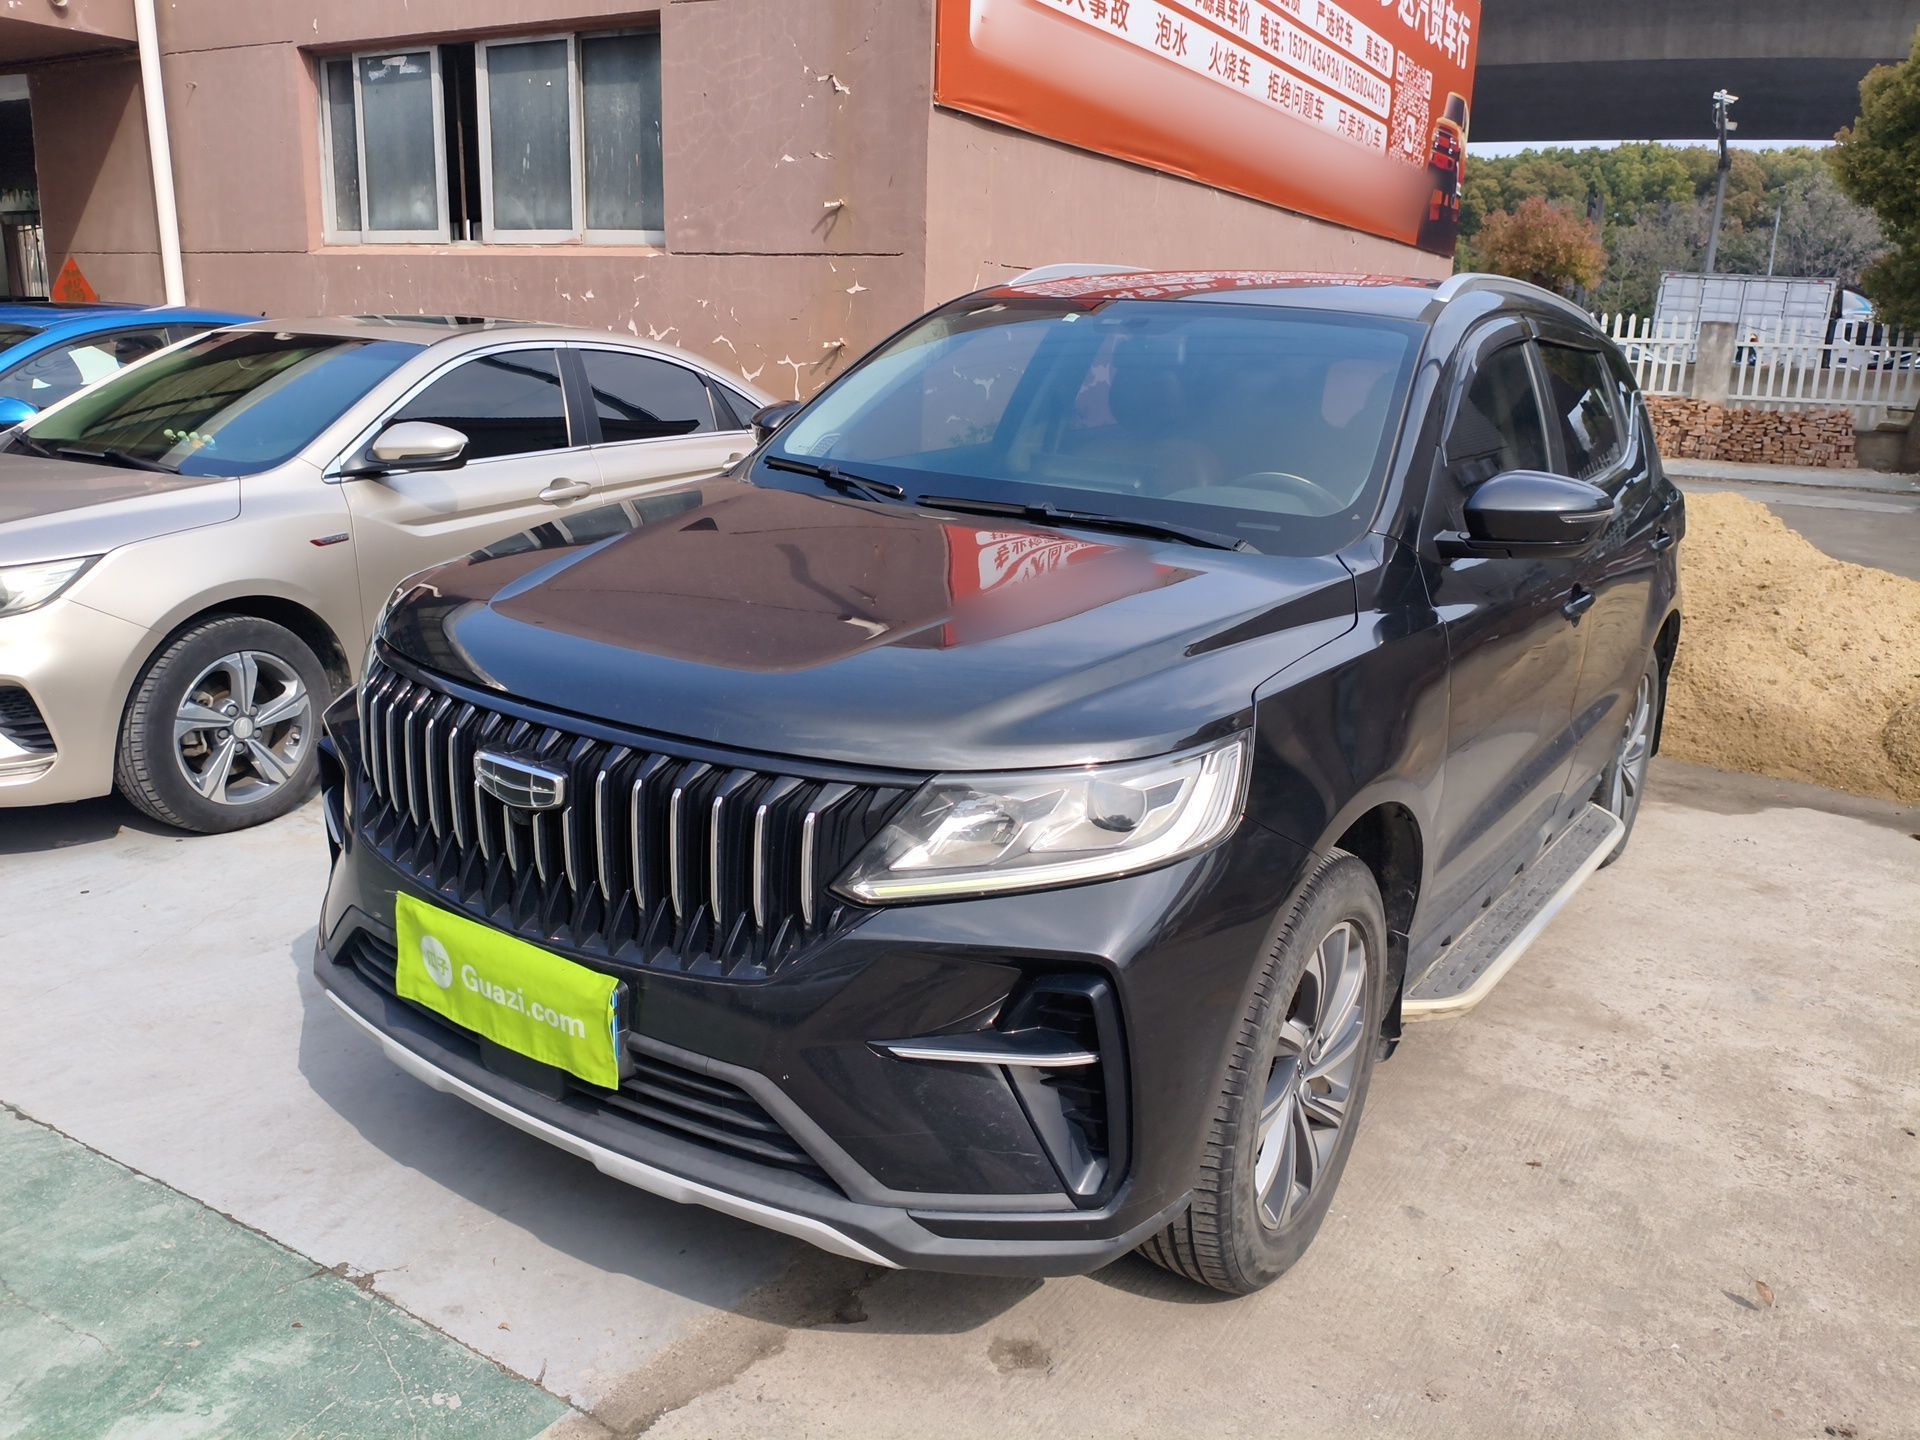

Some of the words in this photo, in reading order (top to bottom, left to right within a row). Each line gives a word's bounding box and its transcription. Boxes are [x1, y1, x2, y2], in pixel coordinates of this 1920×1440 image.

[1195, 0, 1250, 35] 真车价
[1316, 1, 1353, 48] 严选好车
[1365, 34, 1388, 72] 真车况
[1380, 0, 1471, 69] 汽贸车行
[1057, 0, 1130, 32] 事故
[1154, 12, 1188, 57] 泡水
[1208, 41, 1251, 88] 火烧车
[1267, 70, 1324, 123] 拒绝问题车
[1337, 109, 1381, 149] 只卖放心车
[461, 964, 586, 1039] Guazi.com
